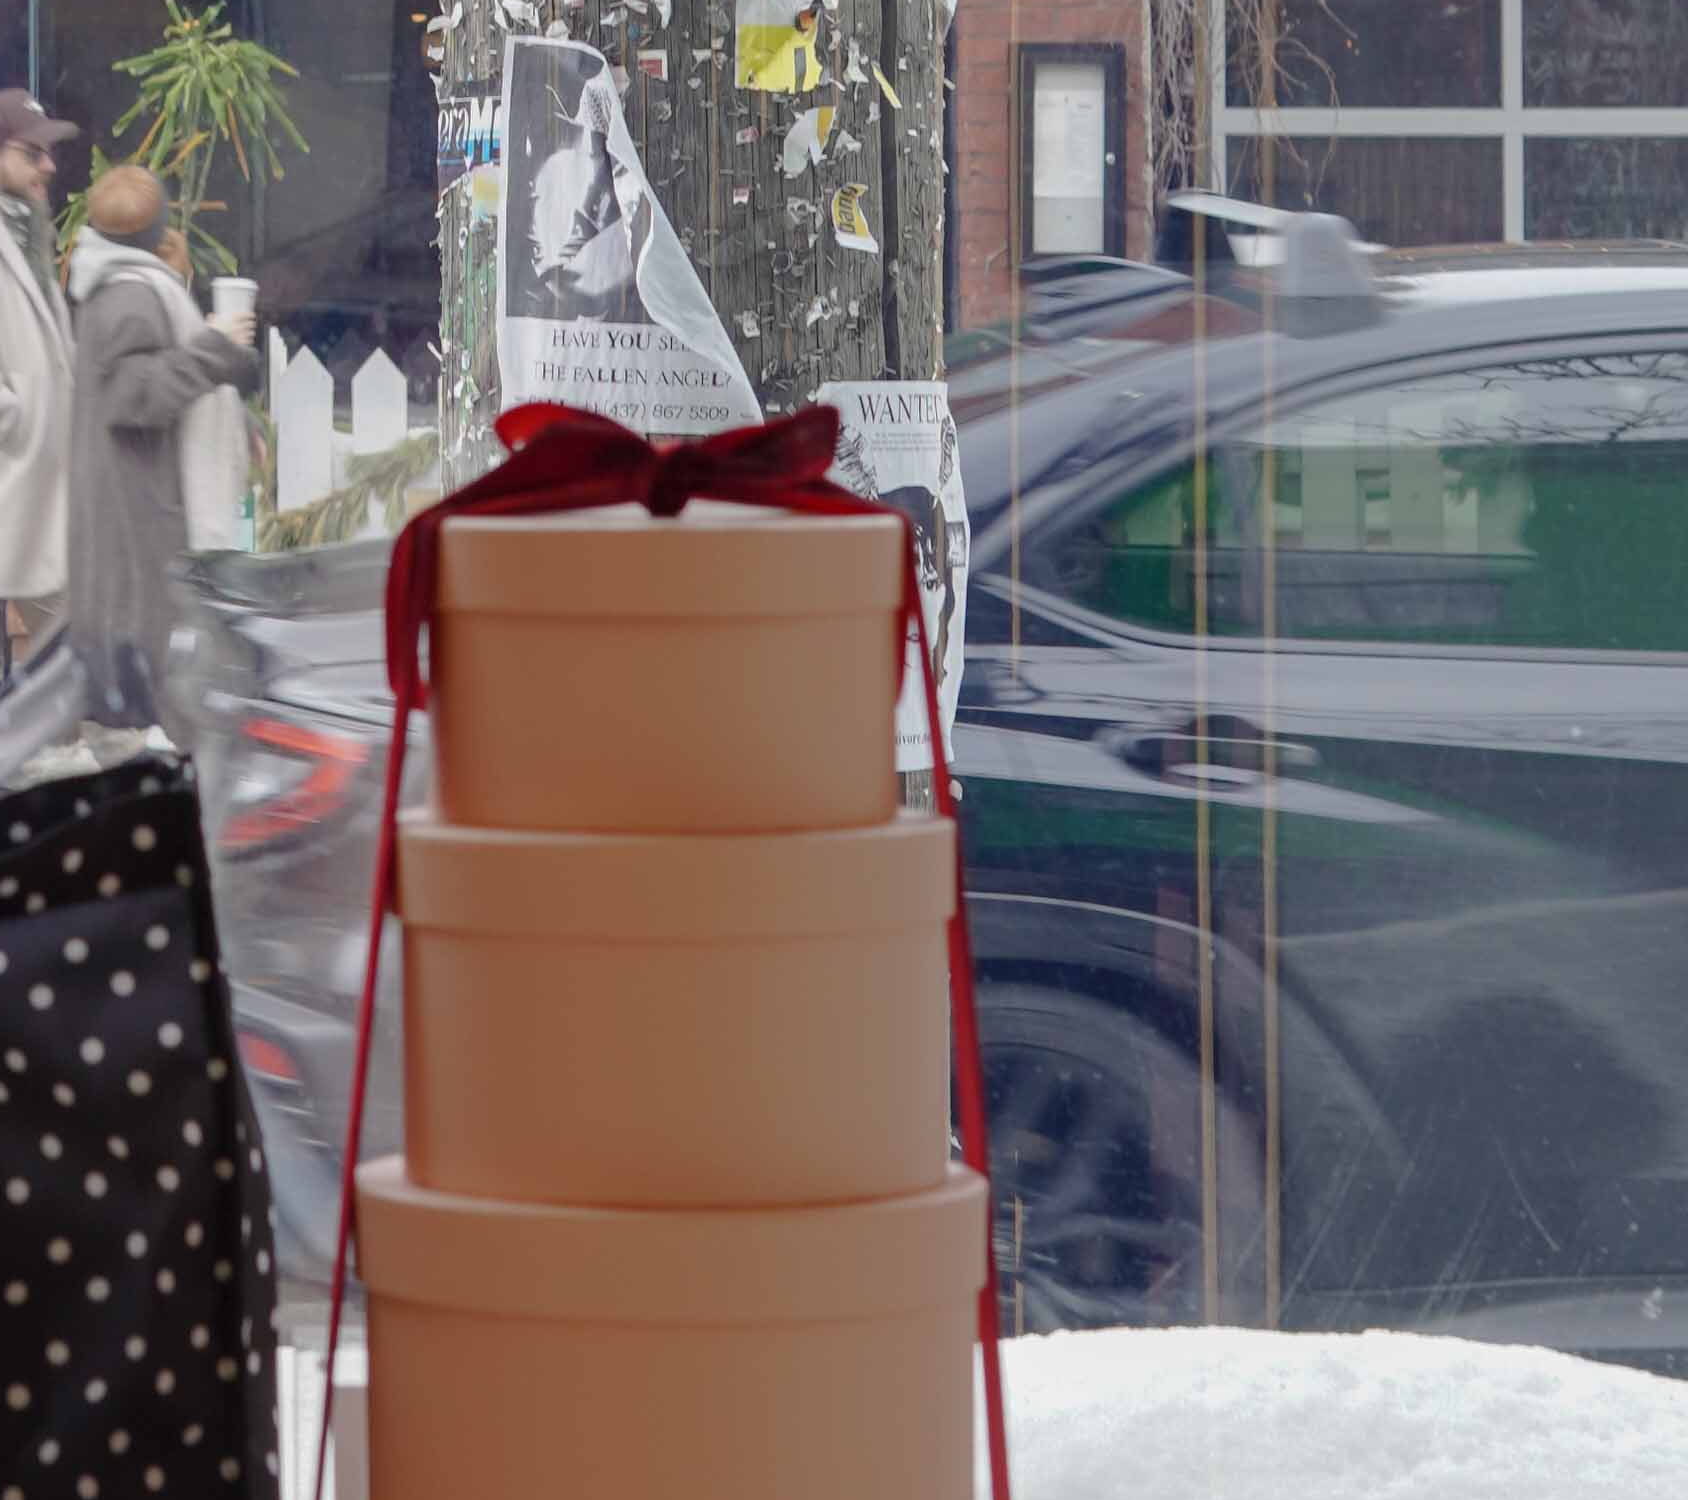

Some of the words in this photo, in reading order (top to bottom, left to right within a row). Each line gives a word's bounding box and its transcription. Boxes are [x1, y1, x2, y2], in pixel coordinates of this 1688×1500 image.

[552, 328, 600, 348] HAVE
[608, 330, 651, 351] YOU
[573, 367, 648, 385] FALLEN
[652, 404, 684, 418] 867
[688, 406, 730, 421] 5509
